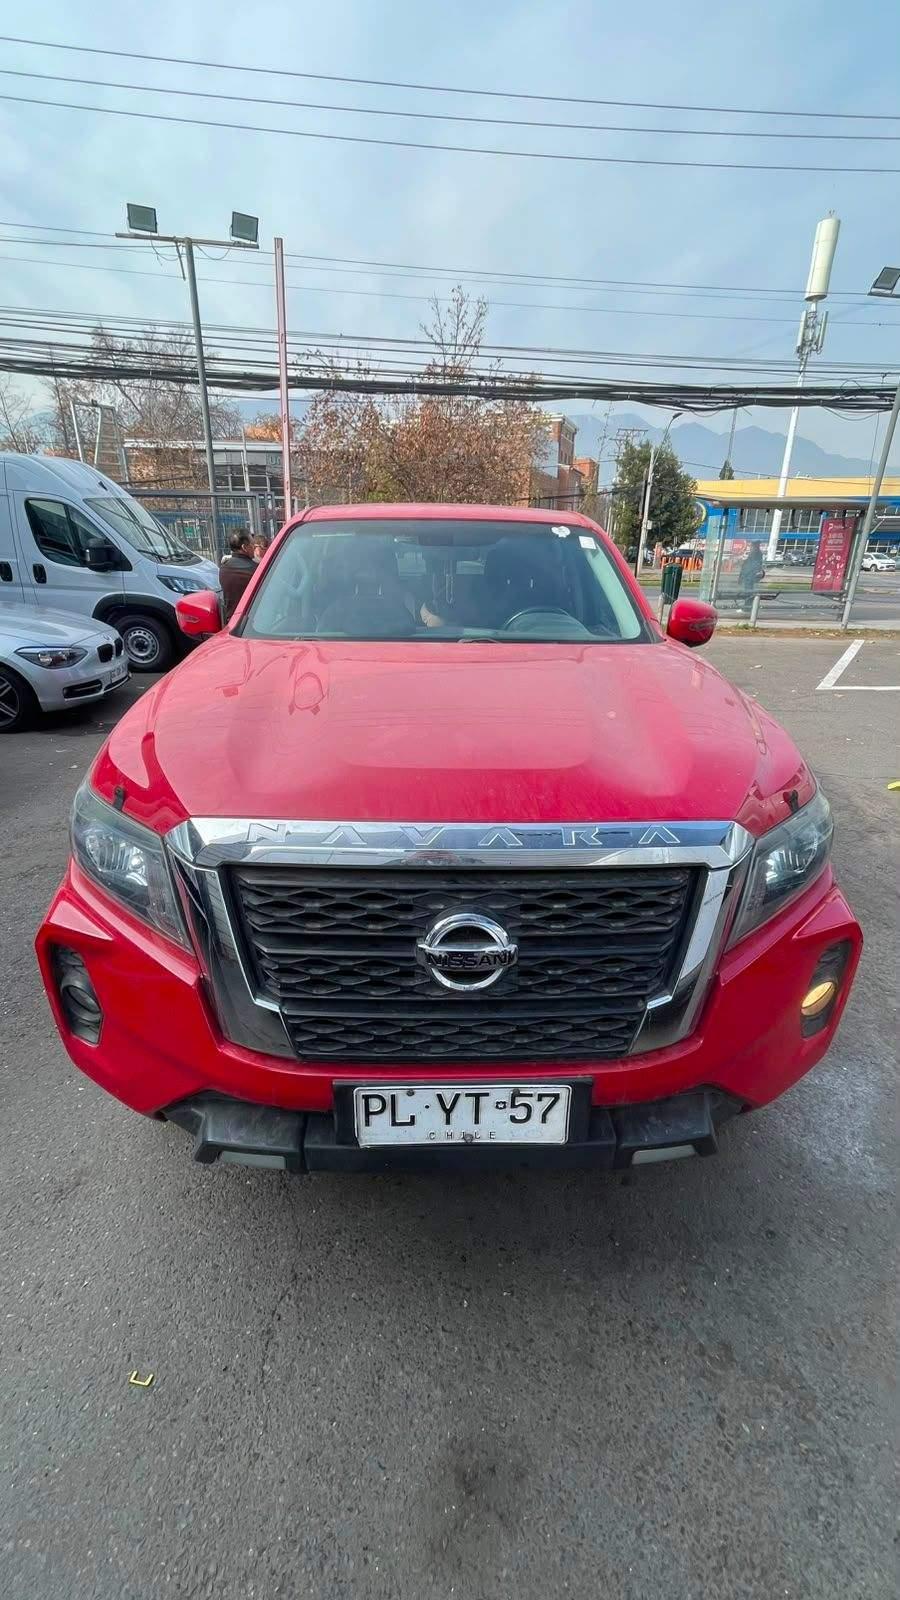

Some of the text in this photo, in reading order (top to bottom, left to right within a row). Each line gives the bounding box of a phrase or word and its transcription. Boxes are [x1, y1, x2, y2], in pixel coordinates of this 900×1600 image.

[246, 823, 681, 846] NAVARA
[425, 950, 515, 968] NISSAN
[428, 1131, 497, 1141] CHILE
